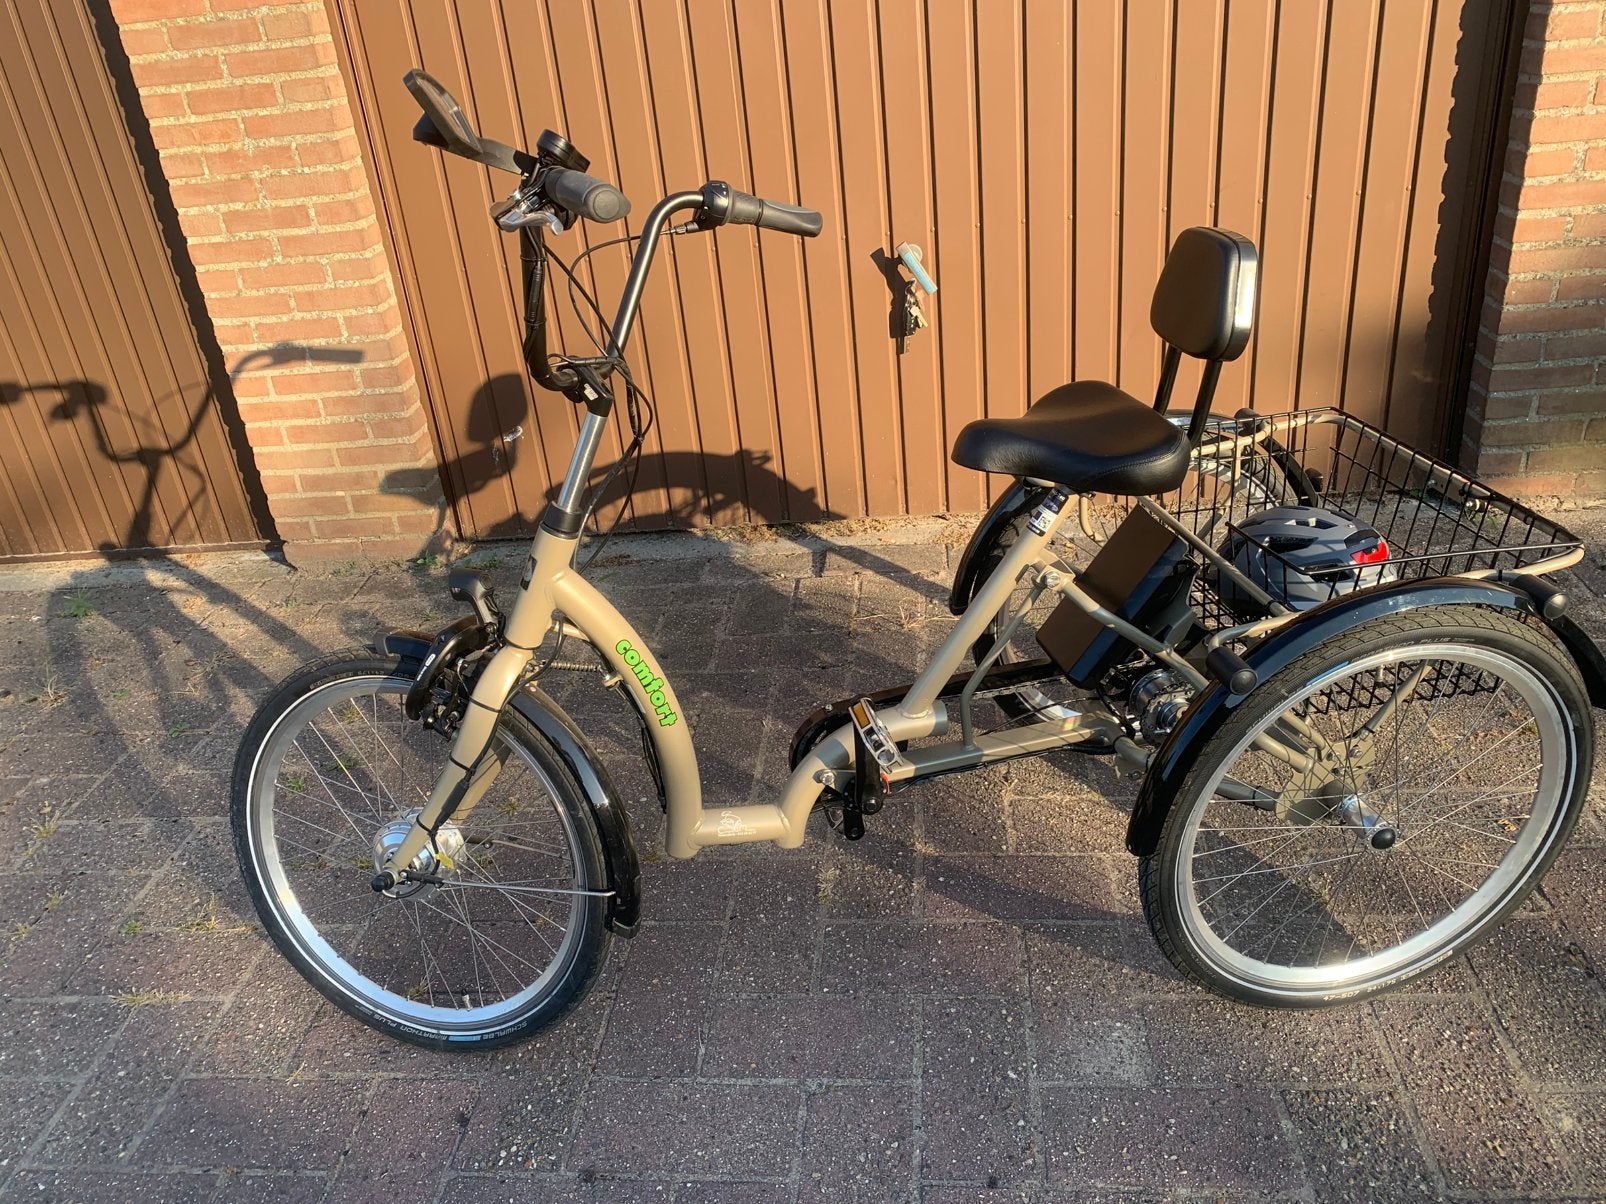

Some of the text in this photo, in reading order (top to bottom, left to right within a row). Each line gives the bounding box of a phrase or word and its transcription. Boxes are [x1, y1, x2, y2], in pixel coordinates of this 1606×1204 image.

[615, 639, 678, 727] comfort
[373, 1013, 448, 1041] MARATHON PLUS
[482, 1020, 528, 1040] SCHWALBE
